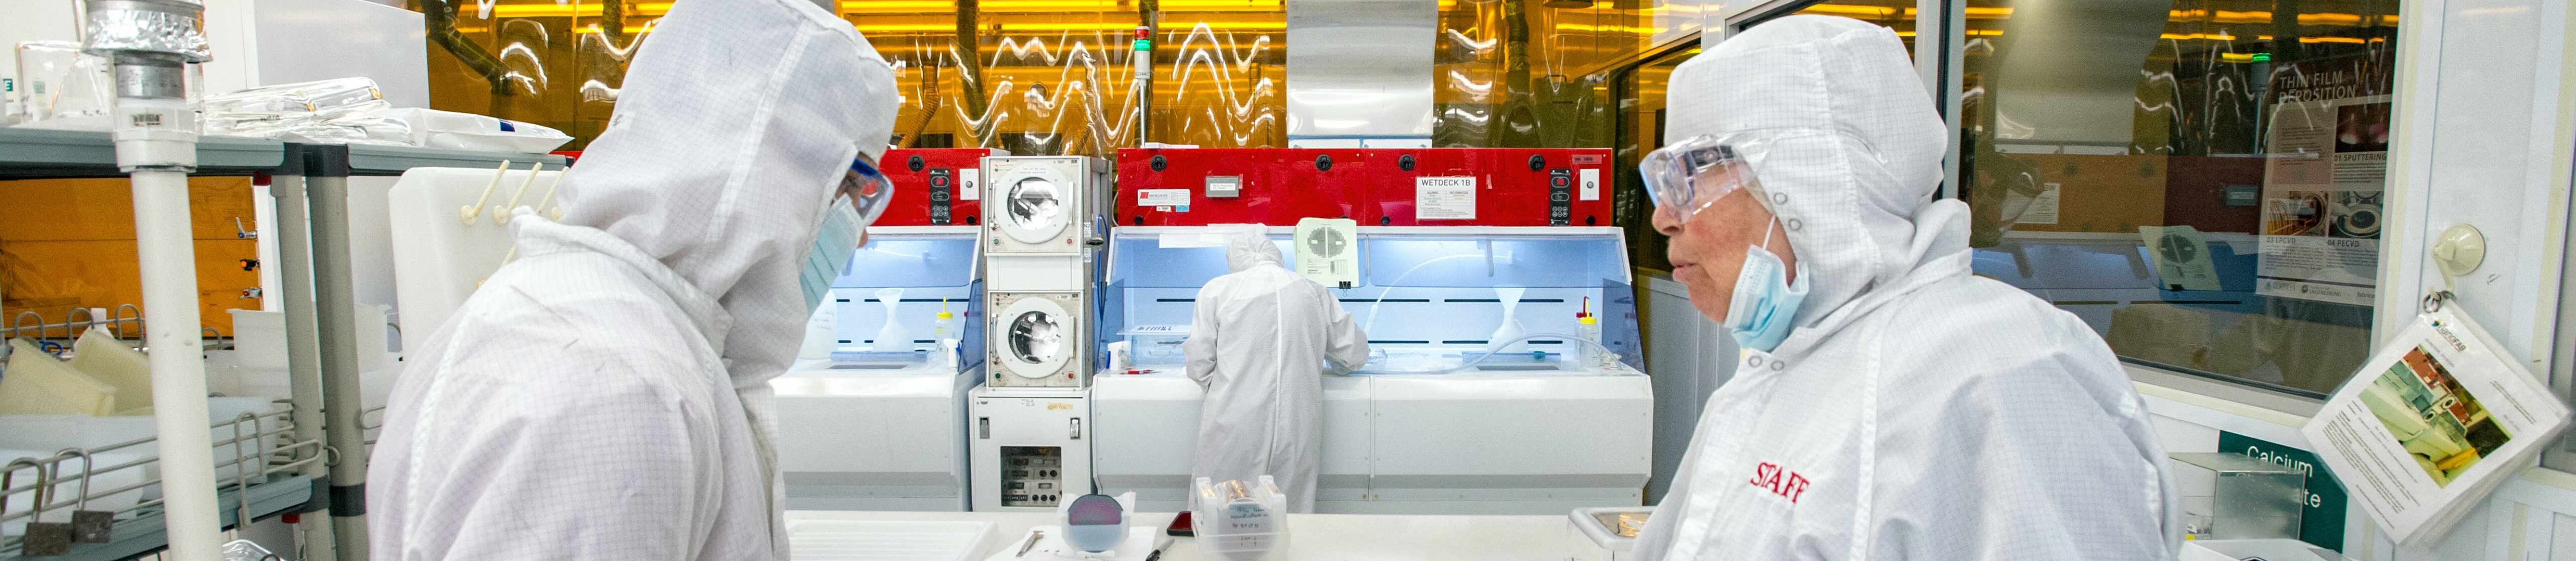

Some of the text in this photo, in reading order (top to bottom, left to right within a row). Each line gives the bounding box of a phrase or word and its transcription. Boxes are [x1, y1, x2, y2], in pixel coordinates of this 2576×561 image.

[2280, 71, 2343, 89] THIN FILM
[2279, 85, 2356, 103] DEPOSITION
[2343, 153, 2387, 161] SPUTTERING
[2337, 240, 2360, 248] PECVD
[2247, 445, 2313, 478] Calcium
[1749, 461, 1811, 504] STAFF
